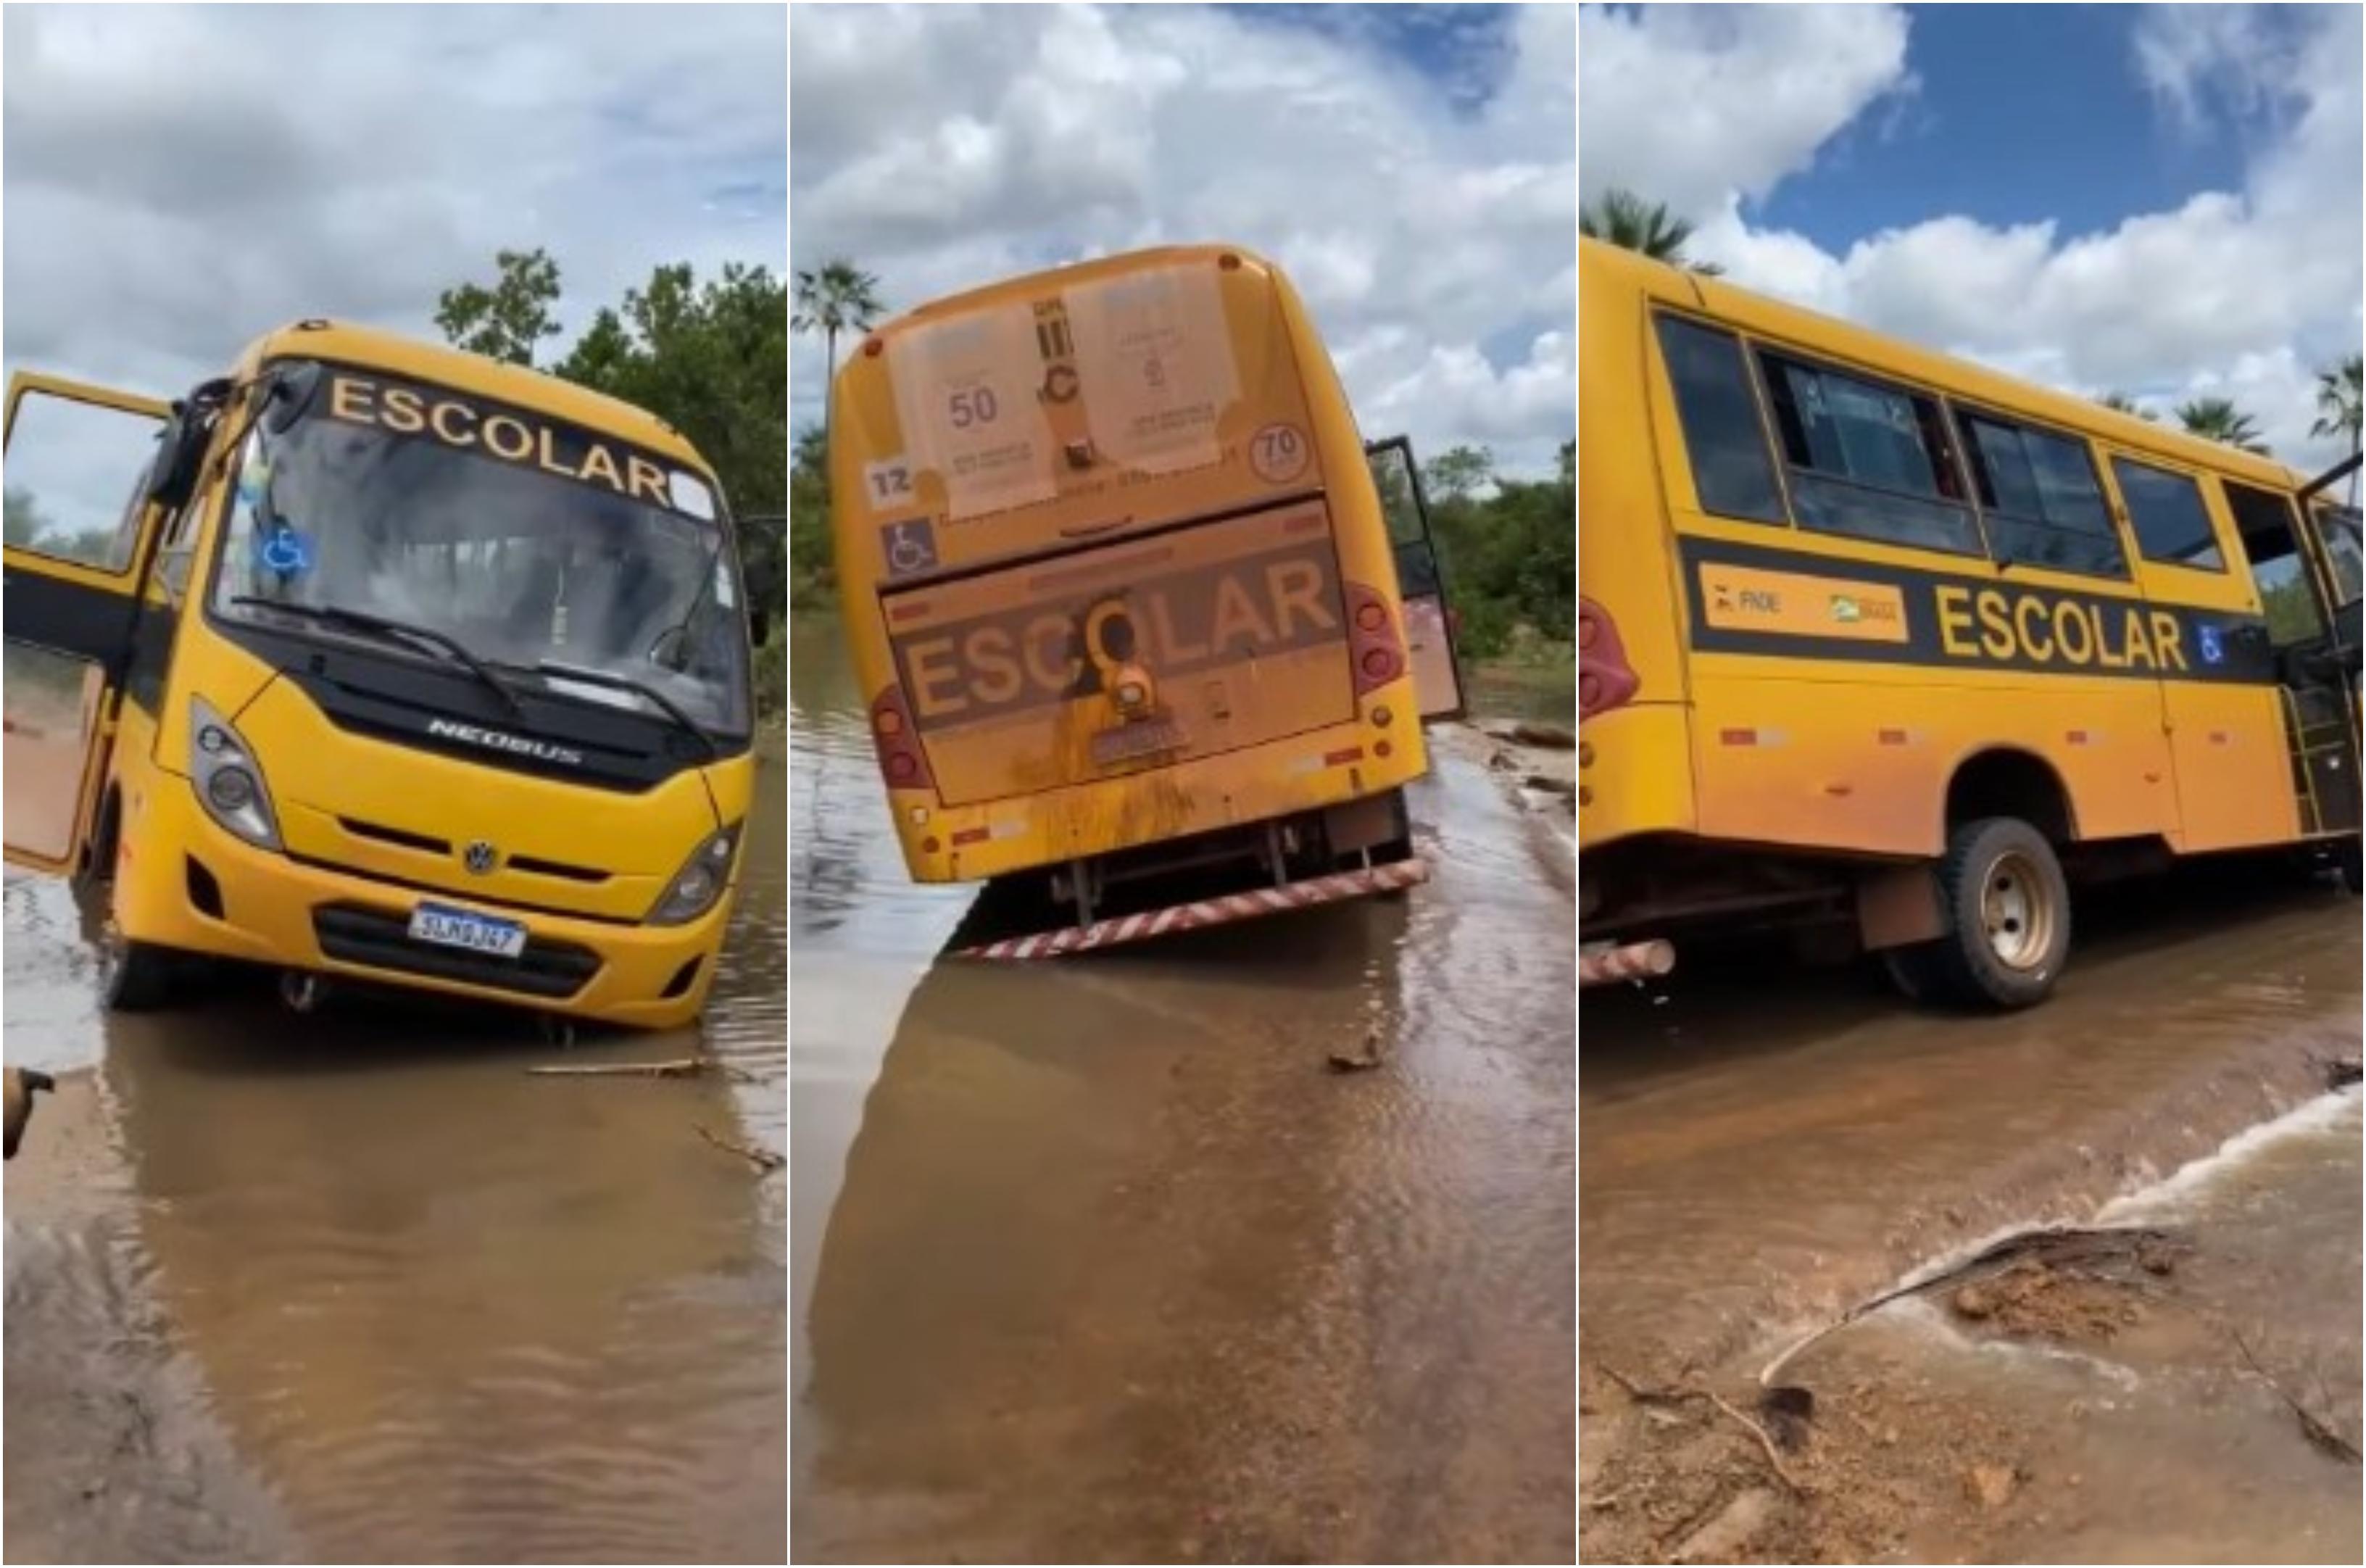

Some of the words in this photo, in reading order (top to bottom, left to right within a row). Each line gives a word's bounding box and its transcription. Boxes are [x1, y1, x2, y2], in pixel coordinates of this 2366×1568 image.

[950, 386, 997, 428] 50
[331, 376, 672, 507] ESCOLAR
[1259, 428, 1297, 459] 70
[872, 465, 911, 497] 12
[906, 559, 1337, 716] ESCOLAR
[1935, 584, 2189, 671] ESCOLAR
[428, 720, 582, 764] NEOBUS
